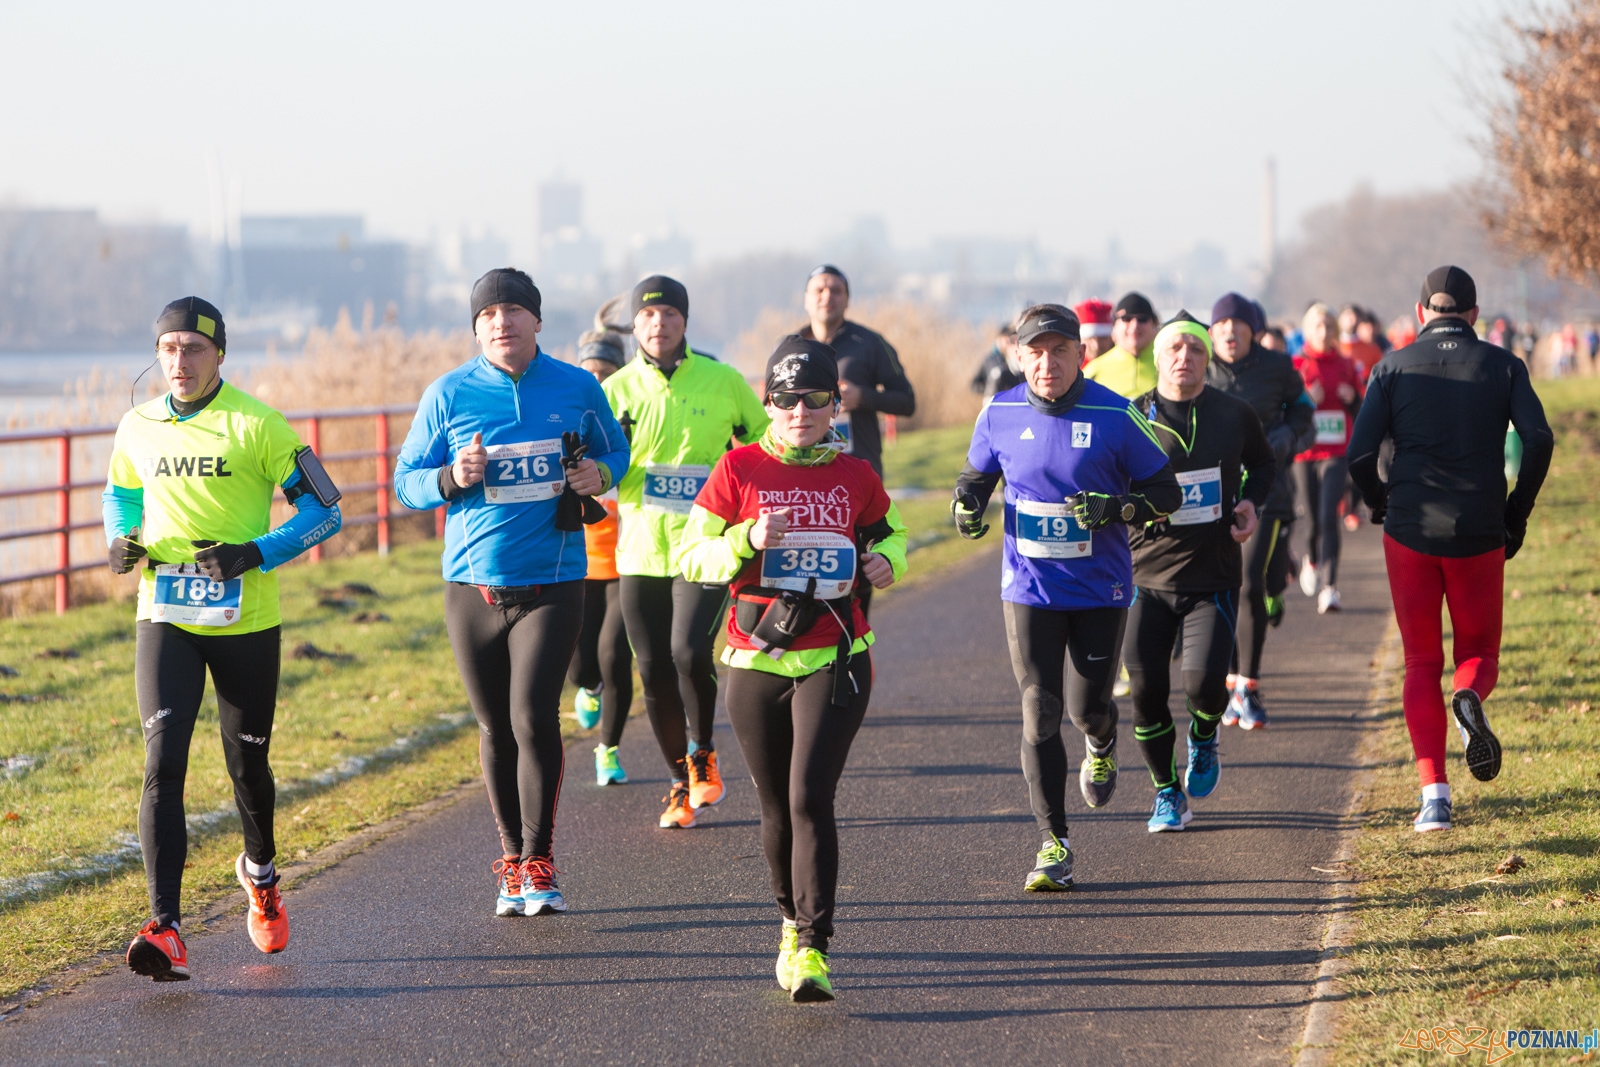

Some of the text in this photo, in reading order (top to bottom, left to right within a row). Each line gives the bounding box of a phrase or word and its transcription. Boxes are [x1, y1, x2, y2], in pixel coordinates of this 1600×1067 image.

[498, 456, 549, 480] 216
[653, 476, 697, 496] 398
[758, 487, 837, 505] DRUŻYNA
[1182, 484, 1203, 504] 4
[1037, 517, 1068, 537] 19
[781, 549, 838, 573] 385
[172, 578, 225, 601] 189
